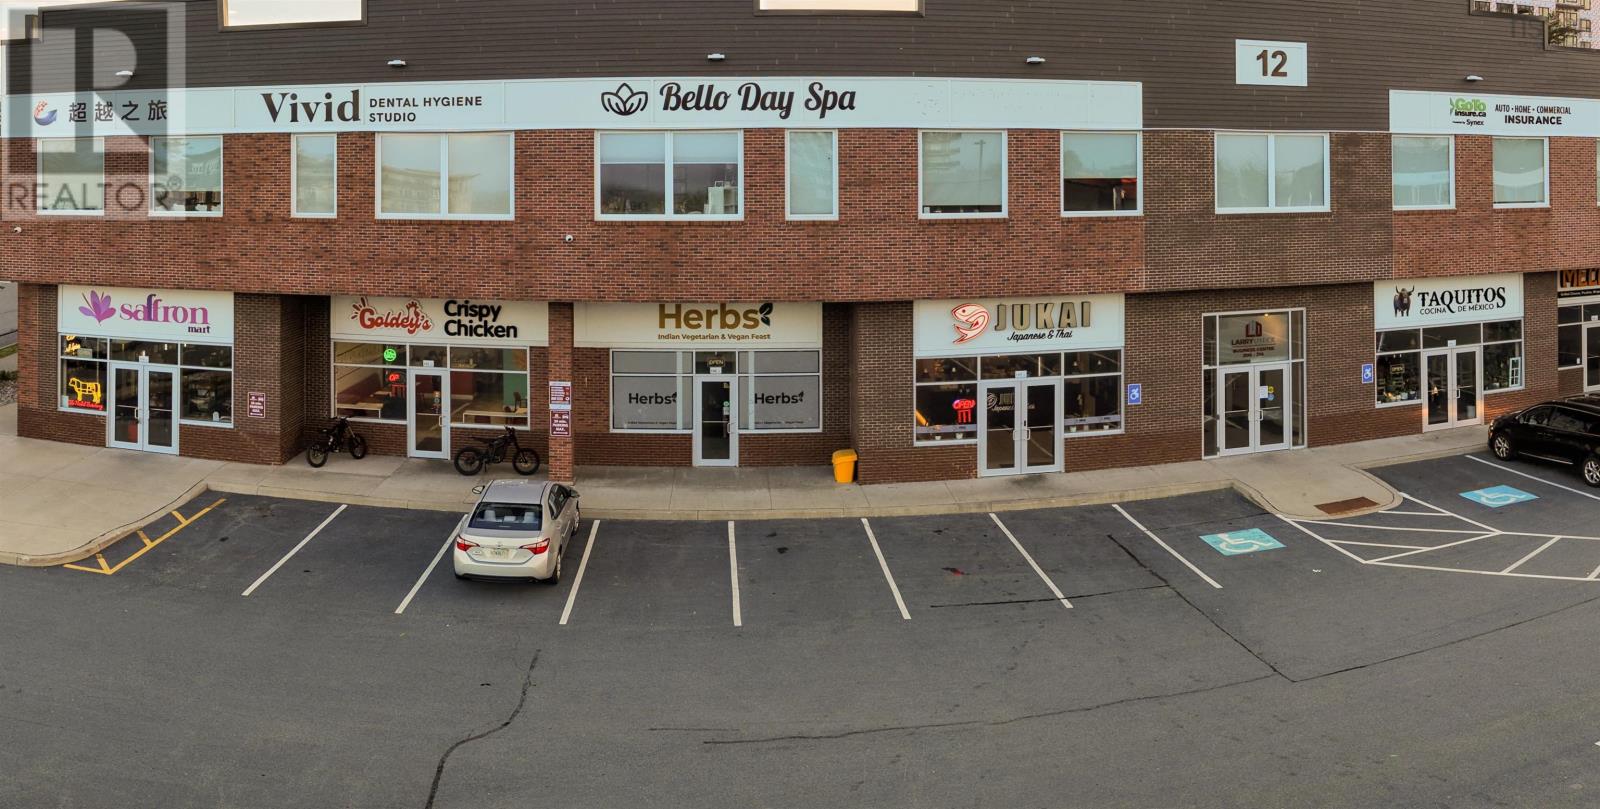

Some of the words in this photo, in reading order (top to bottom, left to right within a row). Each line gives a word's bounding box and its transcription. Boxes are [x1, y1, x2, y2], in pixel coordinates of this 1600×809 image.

[1256, 48, 1288, 77] 12
[262, 90, 361, 123] Vivid
[369, 97, 419, 109] DENTAL
[423, 95, 483, 108] HYGIENE
[659, 82, 732, 112] Bello
[738, 82, 795, 120] Day
[804, 81, 857, 119] Spa
[1455, 98, 1487, 111] GoTo
[67, 99, 168, 123] 超越之旅
[1495, 104, 1510, 113] AUTO
[1514, 105, 1531, 114] HOME
[1536, 106, 1572, 115] COMMERCIAL
[369, 112, 417, 123] STUDIO
[1466, 119, 1484, 127] Synex
[1504, 115, 1563, 125] INSURANCE
[1417, 286, 1506, 313] TAQUITOS
[120, 293, 208, 325] saffron
[444, 299, 502, 323] Crispy
[994, 301, 1091, 331] JUKAI
[1419, 307, 1447, 315] COCINA
[359, 306, 432, 335] Goldey's
[658, 303, 760, 330] Herbs
[187, 325, 210, 334] mart
[444, 319, 518, 338] Chicken
[1007, 330, 1046, 343] Japanese
[1047, 330, 1055, 339] &
[1056, 330, 1073, 338] Thai
[628, 391, 672, 405] Herbs
[754, 391, 799, 404] Herbs
[953, 398, 975, 410] OPEN
